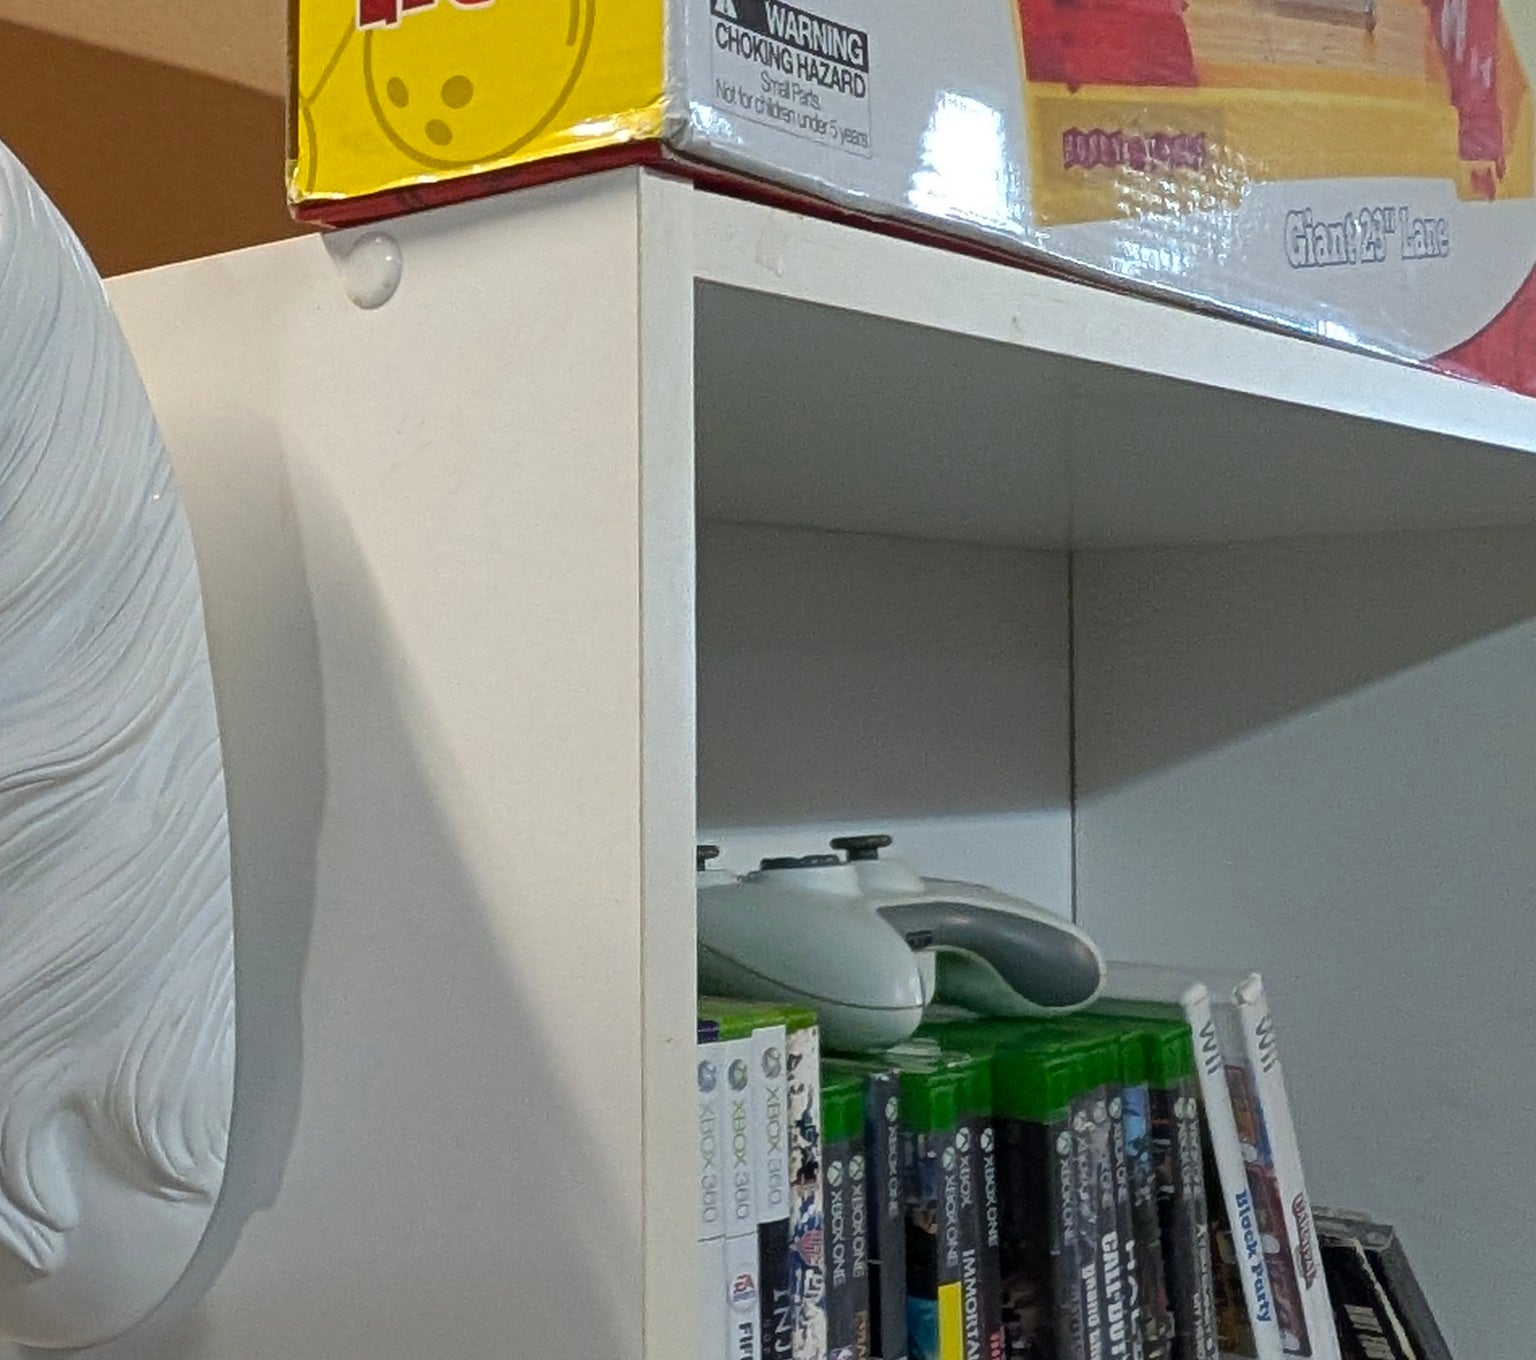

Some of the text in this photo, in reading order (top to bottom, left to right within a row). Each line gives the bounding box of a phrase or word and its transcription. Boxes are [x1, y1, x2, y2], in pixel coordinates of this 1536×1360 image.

[715, 22, 867, 98] CHOKING HAZARD
[765, 0, 864, 66] WARNING
[755, 94, 795, 123] children
[798, 113, 828, 139] under
[1285, 207, 1357, 268] Giant
[1398, 206, 1450, 260] Lane
[766, 1087, 782, 1154] XBOX
[732, 1099, 750, 1221] XBOX 360
[959, 1155, 973, 1209] XBOX
[831, 1190, 847, 1288] XBOX ONE
[851, 1183, 865, 1278] XBOX ONE
[944, 1175, 960, 1269] XBOX ONE
[983, 1154, 999, 1248] XBOX ONE
[1101, 1230, 1123, 1300] CALL
[1235, 1189, 1271, 1323] Block Party
